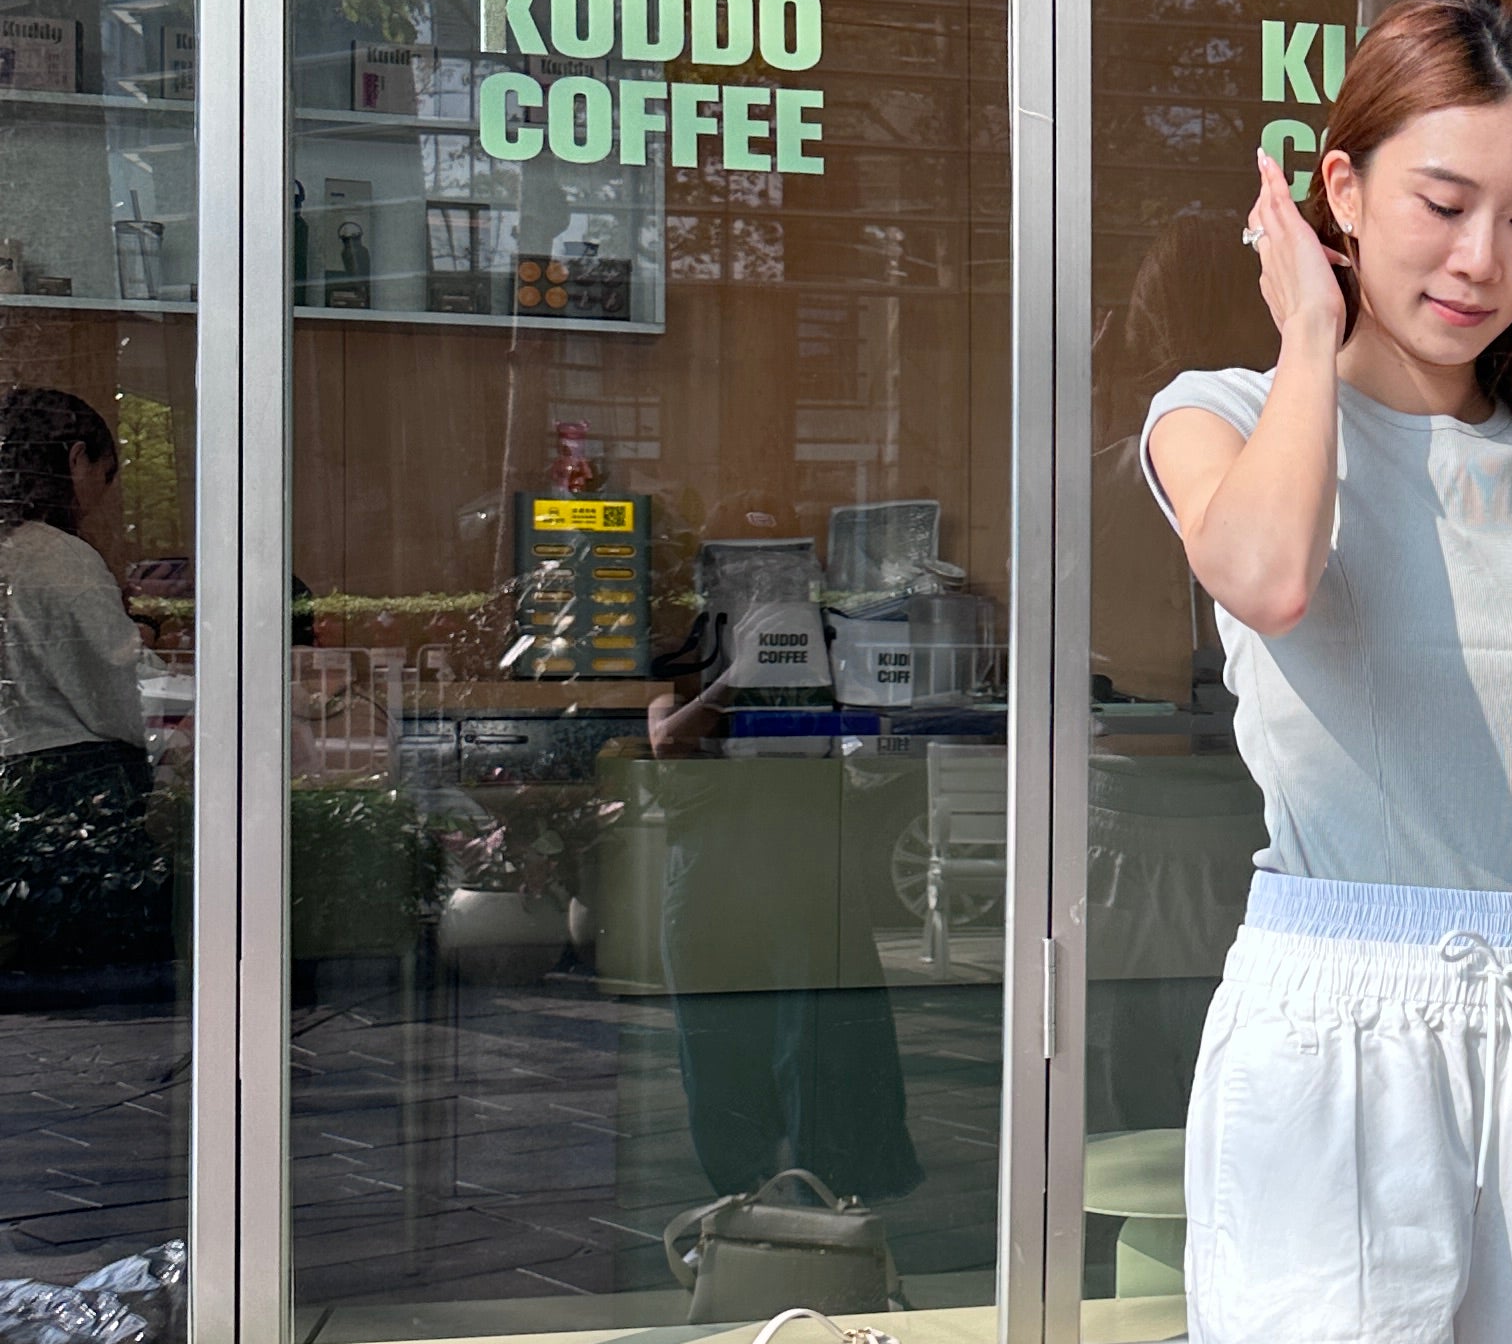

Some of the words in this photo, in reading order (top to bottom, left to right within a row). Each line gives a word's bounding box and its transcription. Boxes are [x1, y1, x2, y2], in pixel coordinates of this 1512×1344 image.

[478, 73, 825, 174] COFFEE
[758, 633, 809, 647] KUDDO
[757, 650, 808, 664] COFFEE
